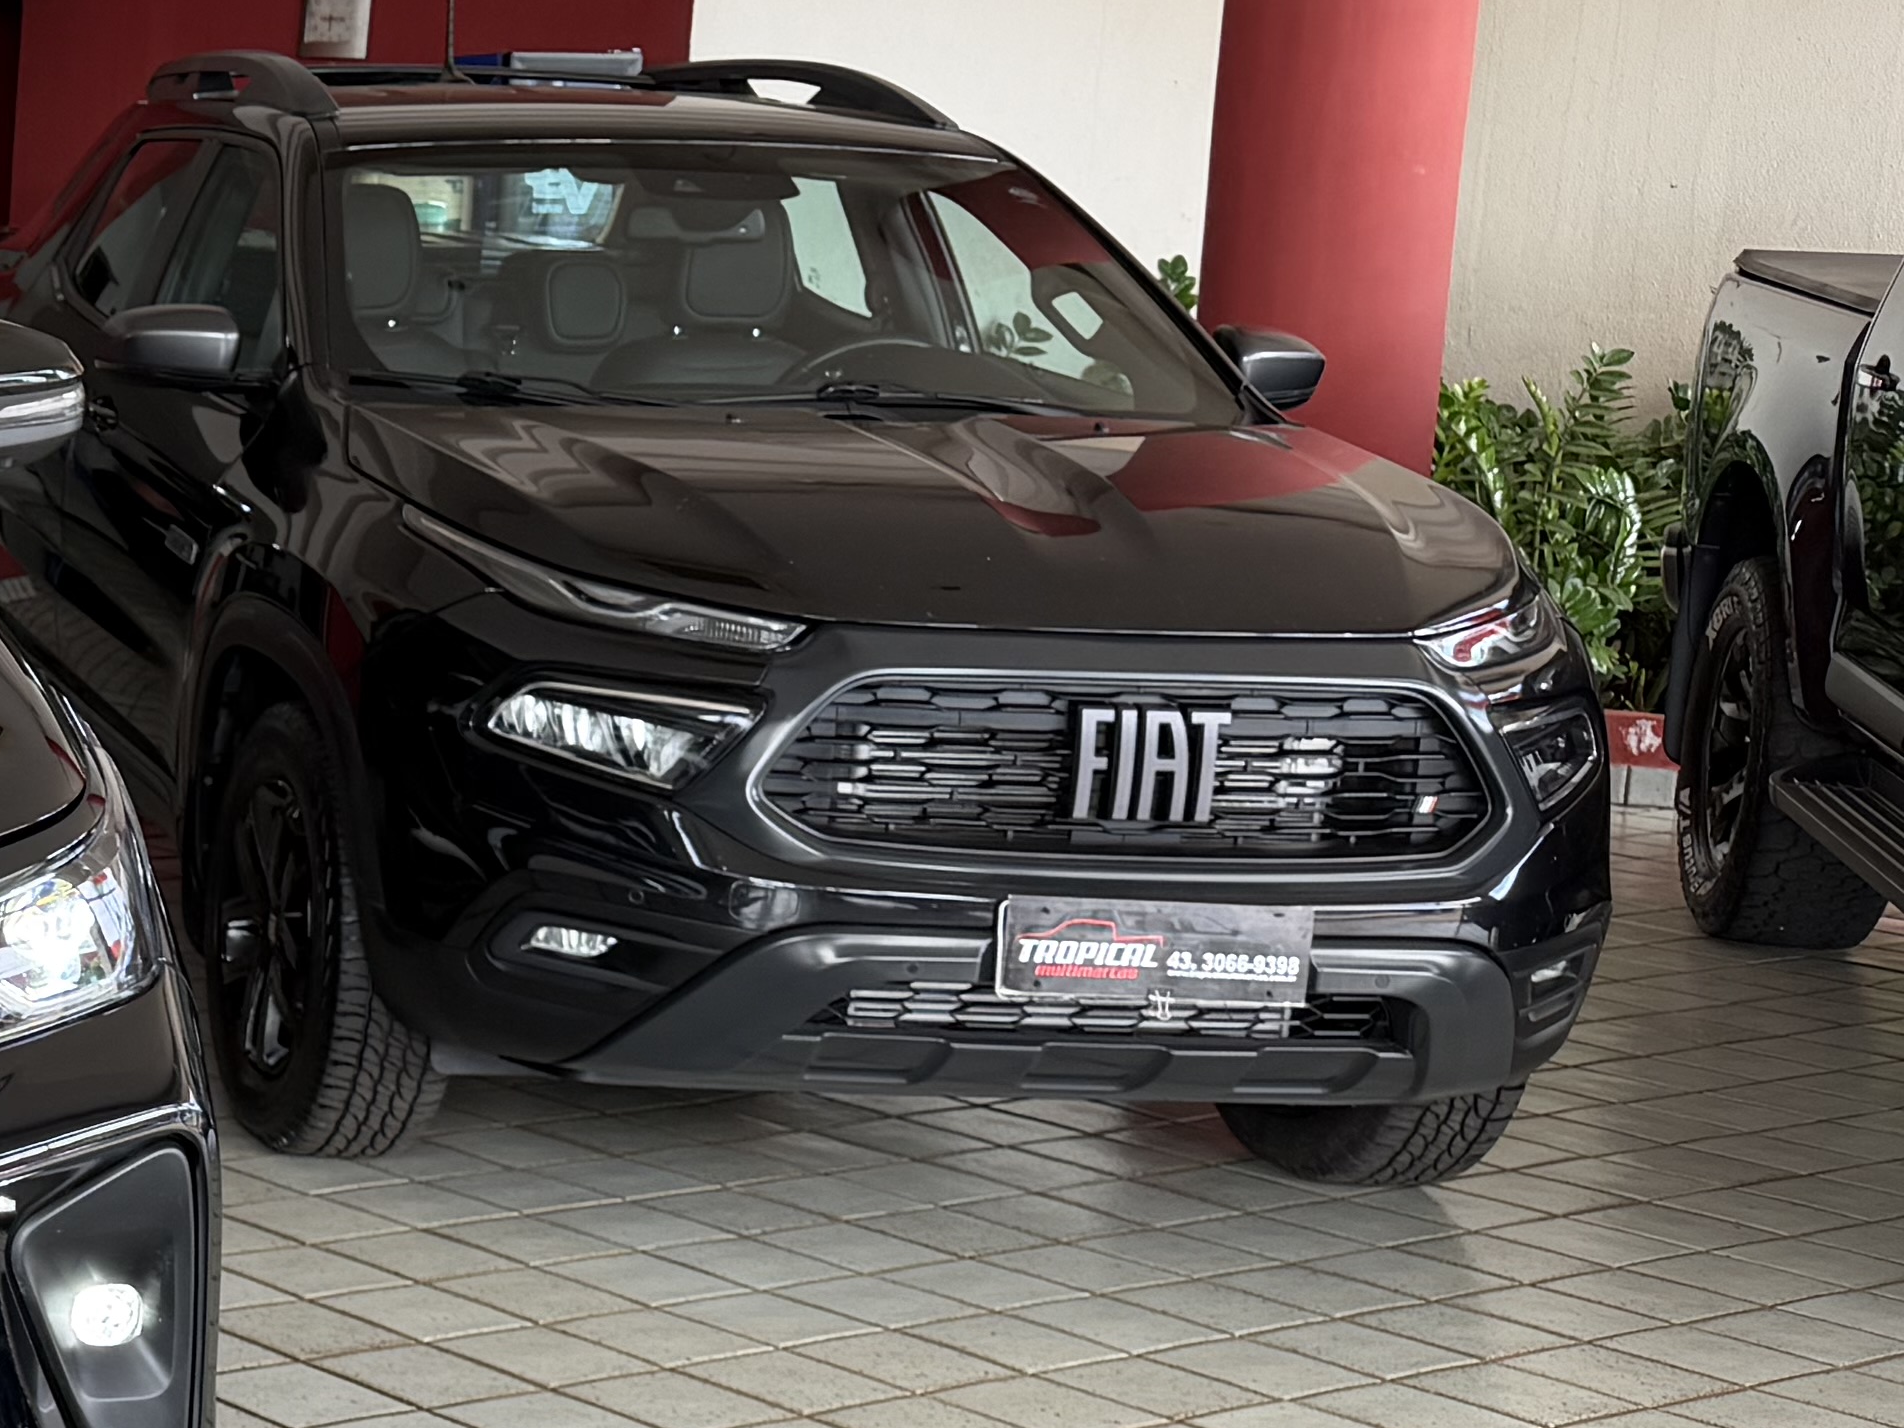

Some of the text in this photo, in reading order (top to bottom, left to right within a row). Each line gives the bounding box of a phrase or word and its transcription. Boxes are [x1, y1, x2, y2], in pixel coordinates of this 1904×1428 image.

[1073, 708, 1232, 822] FIAT
[1018, 938, 1159, 968] TROPICAL
[1201, 951, 1301, 976] 3066-9398
